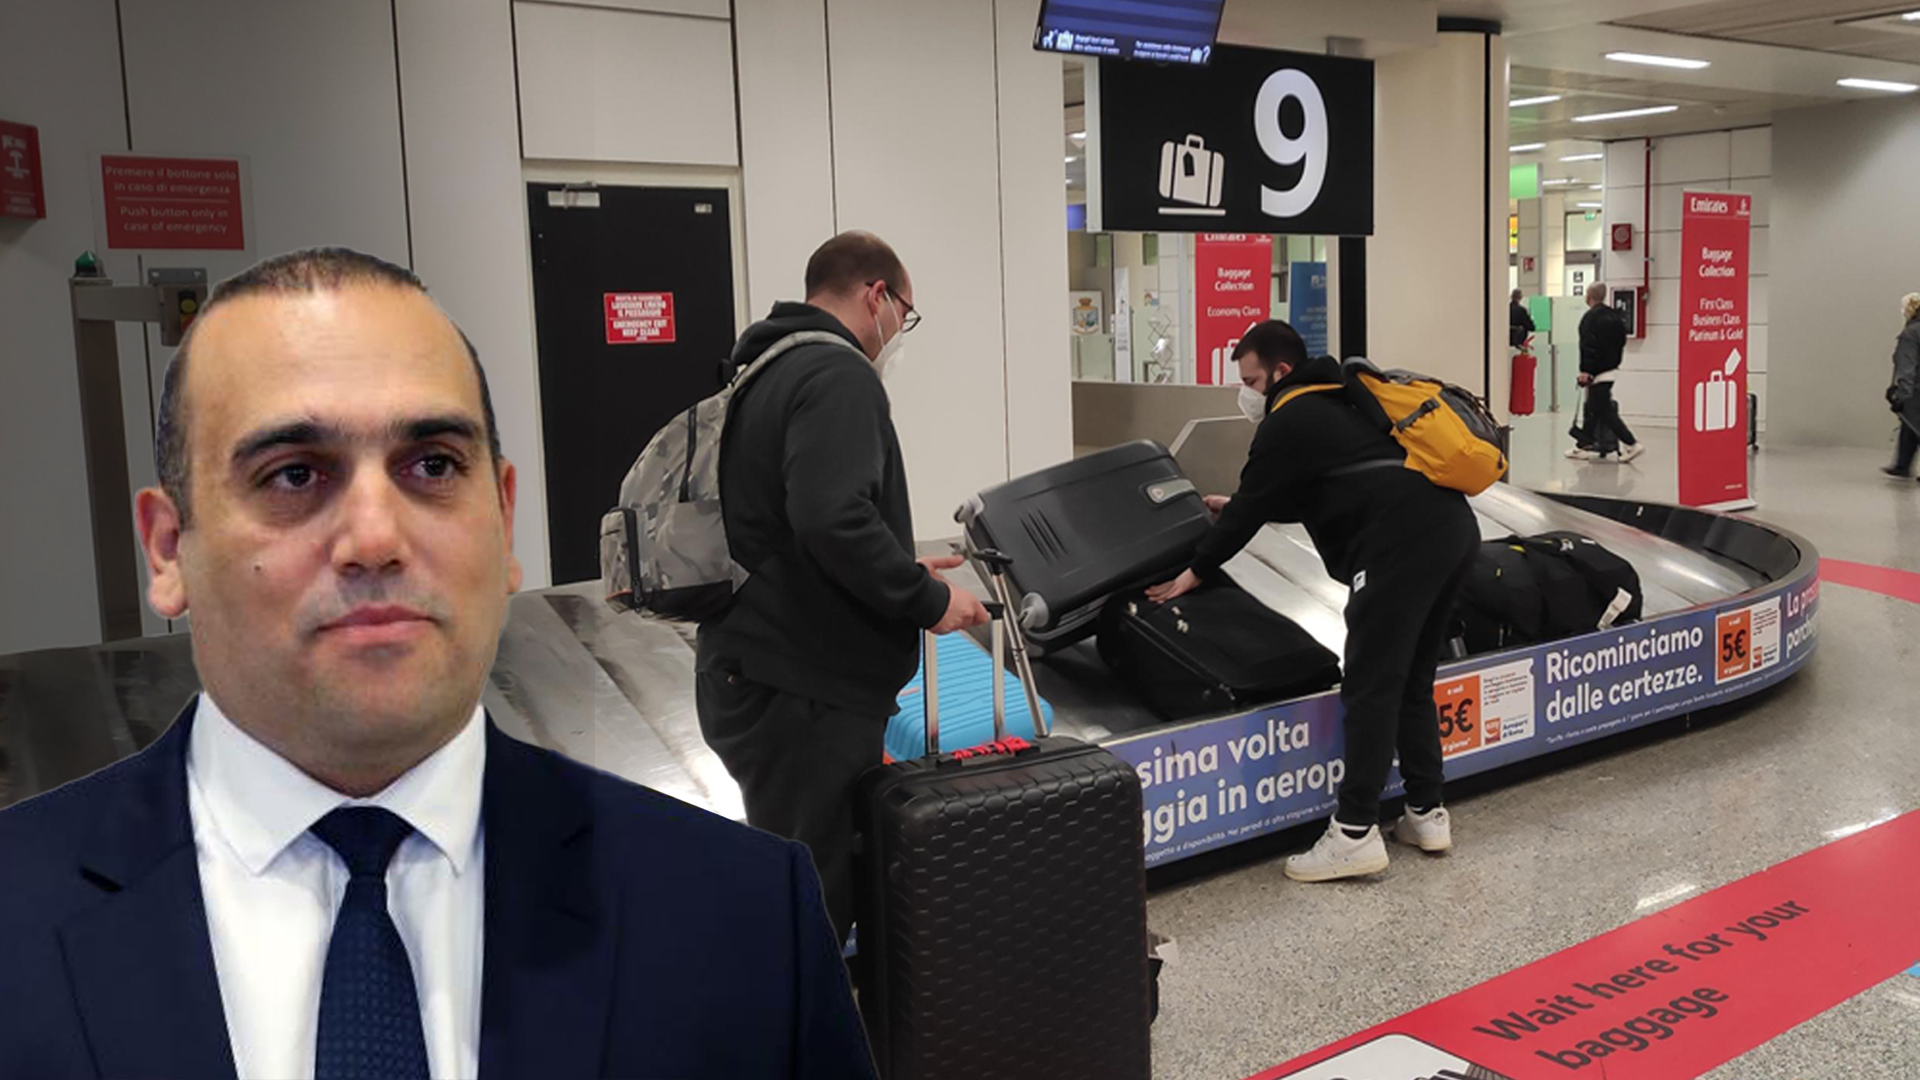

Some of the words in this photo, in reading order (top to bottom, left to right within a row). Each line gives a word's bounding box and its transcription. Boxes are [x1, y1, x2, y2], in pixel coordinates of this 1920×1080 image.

[1254, 68, 1328, 218] 9
[105, 165, 154, 178] Premere
[157, 167, 164, 178] il
[167, 167, 211, 180] bottone
[214, 170, 237, 181] solo
[114, 182, 125, 192] in
[128, 183, 154, 193] caso
[157, 183, 168, 193] di
[170, 184, 231, 197] emergenza
[120, 205, 149, 217] Push
[151, 206, 189, 218] button
[192, 207, 216, 219] only
[218, 209, 229, 218] in
[1690, 196, 1729, 214] Emirates
[124, 223, 149, 232] case
[151, 221, 164, 232] of
[166, 223, 228, 235] emergency
[1702, 247, 1733, 262] Baggage
[1217, 267, 1252, 280] Baggage
[1698, 265, 1735, 278] Collection
[1214, 280, 1255, 293] Collection
[1206, 305, 1241, 319] Economy
[1241, 305, 1262, 318] Class
[1715, 297, 1734, 311] Class
[1692, 313, 1721, 327] Business
[1722, 312, 1741, 326] Class
[1688, 328, 1720, 342] Platinum
[1726, 327, 1744, 341] Gold
[1787, 592, 1799, 618] La
[1722, 629, 1747, 663] 5€
[1546, 627, 1703, 685] Ricominciamo
[1546, 683, 1604, 723] dalle
[1608, 664, 1703, 706] certezze.
[1440, 698, 1474, 738] 5€
[1136, 744, 1218, 790] sima
[1227, 719, 1310, 764] volta
[1218, 779, 1247, 816] in
[1255, 757, 1346, 804] aerop
[1472, 993, 1595, 1042] Wait
[1572, 958, 1680, 1000] here
[1661, 932, 1734, 962] for
[1724, 899, 1811, 941] your
[1534, 986, 1730, 1070] baggage
